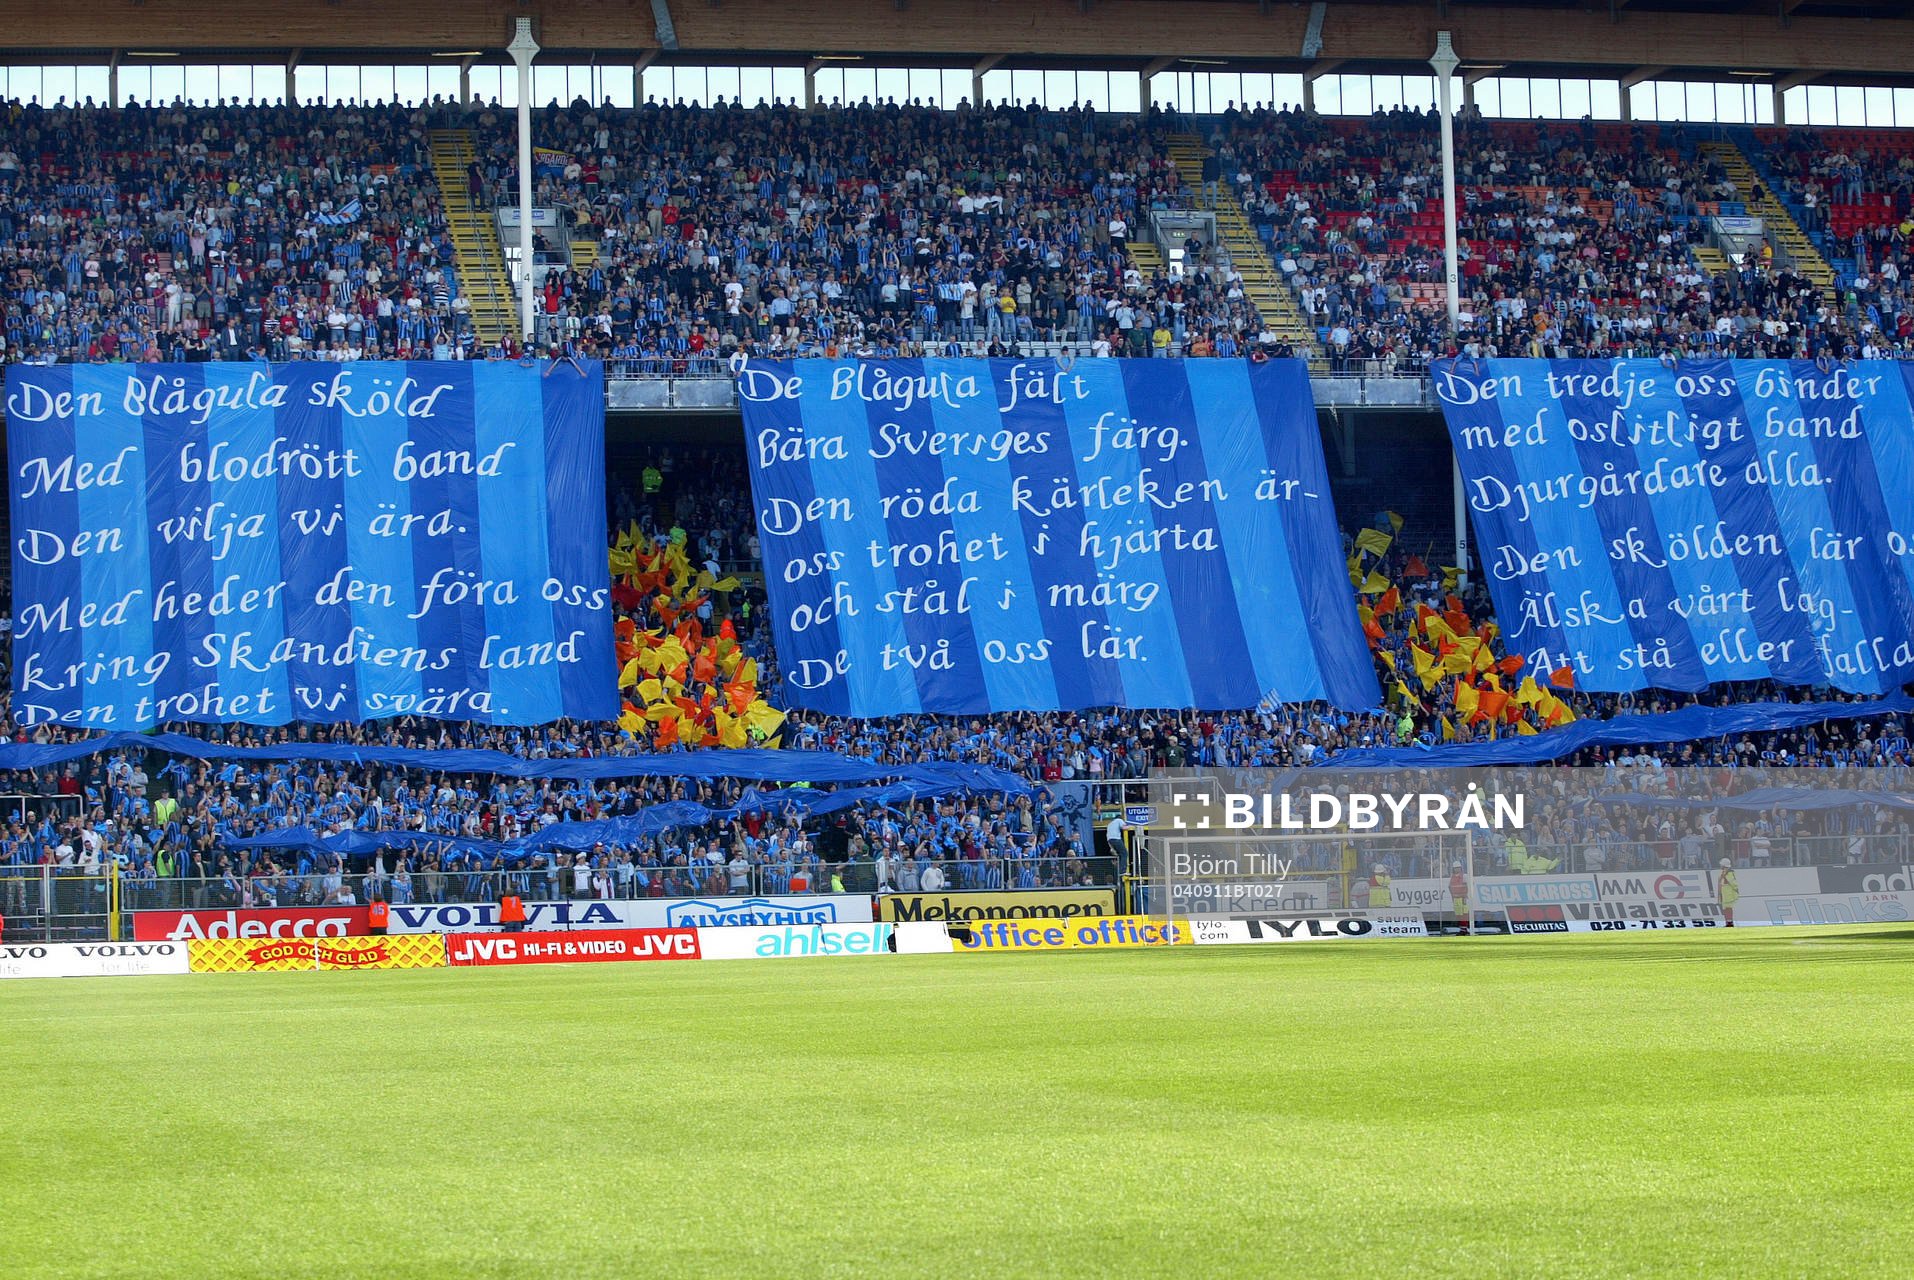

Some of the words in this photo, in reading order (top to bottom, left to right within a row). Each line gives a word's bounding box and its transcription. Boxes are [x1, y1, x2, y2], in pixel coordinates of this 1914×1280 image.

[523, 272, 531, 283] 4
[1449, 273, 1457, 284] 3
[7, 381, 104, 422] Den
[123, 370, 289, 425] Blågula
[739, 367, 804, 401] De
[830, 363, 981, 412] Blågula
[999, 363, 1090, 413] fält
[1436, 370, 1522, 405] Den
[1544, 361, 1656, 410] tredje
[1675, 375, 1736, 398] oss
[1755, 367, 1882, 400] binder
[758, 426, 849, 469] Bära
[1082, 411, 1188, 462] färg.
[1460, 407, 1548, 450] med
[1765, 404, 1864, 439] band
[20, 446, 138, 499] Med
[180, 437, 362, 483] blodrött
[393, 440, 516, 482] band
[1471, 457, 1727, 522] Djurgårdare
[1745, 449, 1832, 487] alla.
[761, 497, 854, 536] Den
[879, 476, 982, 519] röda
[18, 527, 123, 565] Den
[157, 501, 266, 561] vilja
[290, 503, 343, 536] vi
[368, 503, 466, 537] ära.
[1459, 539, 1466, 550] 5
[783, 551, 845, 583] oss
[866, 529, 1009, 568] trohet
[1032, 523, 1050, 555] i
[1079, 520, 1218, 570] hjärta
[1493, 544, 1582, 581] Den
[1810, 527, 1863, 561] lär
[14, 589, 143, 639] Med
[153, 574, 287, 622] heder
[315, 565, 395, 607] den
[407, 567, 519, 619] föra
[541, 577, 608, 610] oss
[790, 581, 859, 632] och
[875, 576, 978, 615] stål
[998, 580, 1016, 610] i
[1047, 572, 1160, 612] märg
[1667, 584, 1756, 619] vårt
[479, 630, 585, 669] land
[788, 649, 852, 689] De
[879, 638, 955, 671] två
[983, 639, 1053, 664] oss
[1081, 620, 1147, 662] lär.
[1619, 637, 1676, 669] stå
[1701, 627, 1794, 665] eller
[1819, 633, 1914, 678] falla
[13, 704, 117, 728] Den
[134, 682, 276, 723] trohet
[294, 683, 347, 712] vi
[365, 687, 509, 714] svära.
[1396, 887, 1446, 905] bygger
[1479, 884, 1520, 902] SALA
[1527, 882, 1593, 901] KAROSS
[890, 897, 1103, 921] Mekonomen
[1377, 915, 1418, 923] sauna
[1566, 902, 1724, 921] Villalarm
[1765, 896, 1909, 926] Flinks
[166, 911, 352, 940] Adecco
[756, 922, 892, 957] ahlsell
[961, 921, 1065, 949] office
[1078, 919, 1181, 946] office
[1199, 931, 1229, 940] com
[1380, 925, 1421, 934] steam
[1513, 922, 1566, 932] SECURITAS
[73, 944, 175, 957] VOLVO
[260, 945, 294, 961] GOD
[297, 945, 334, 961] OCH
[336, 950, 380, 964] GLAD
[455, 939, 518, 961] JVC
[524, 941, 563, 956] HI-FI
[578, 940, 627, 955] VIDEO
[633, 933, 696, 956] JVC
